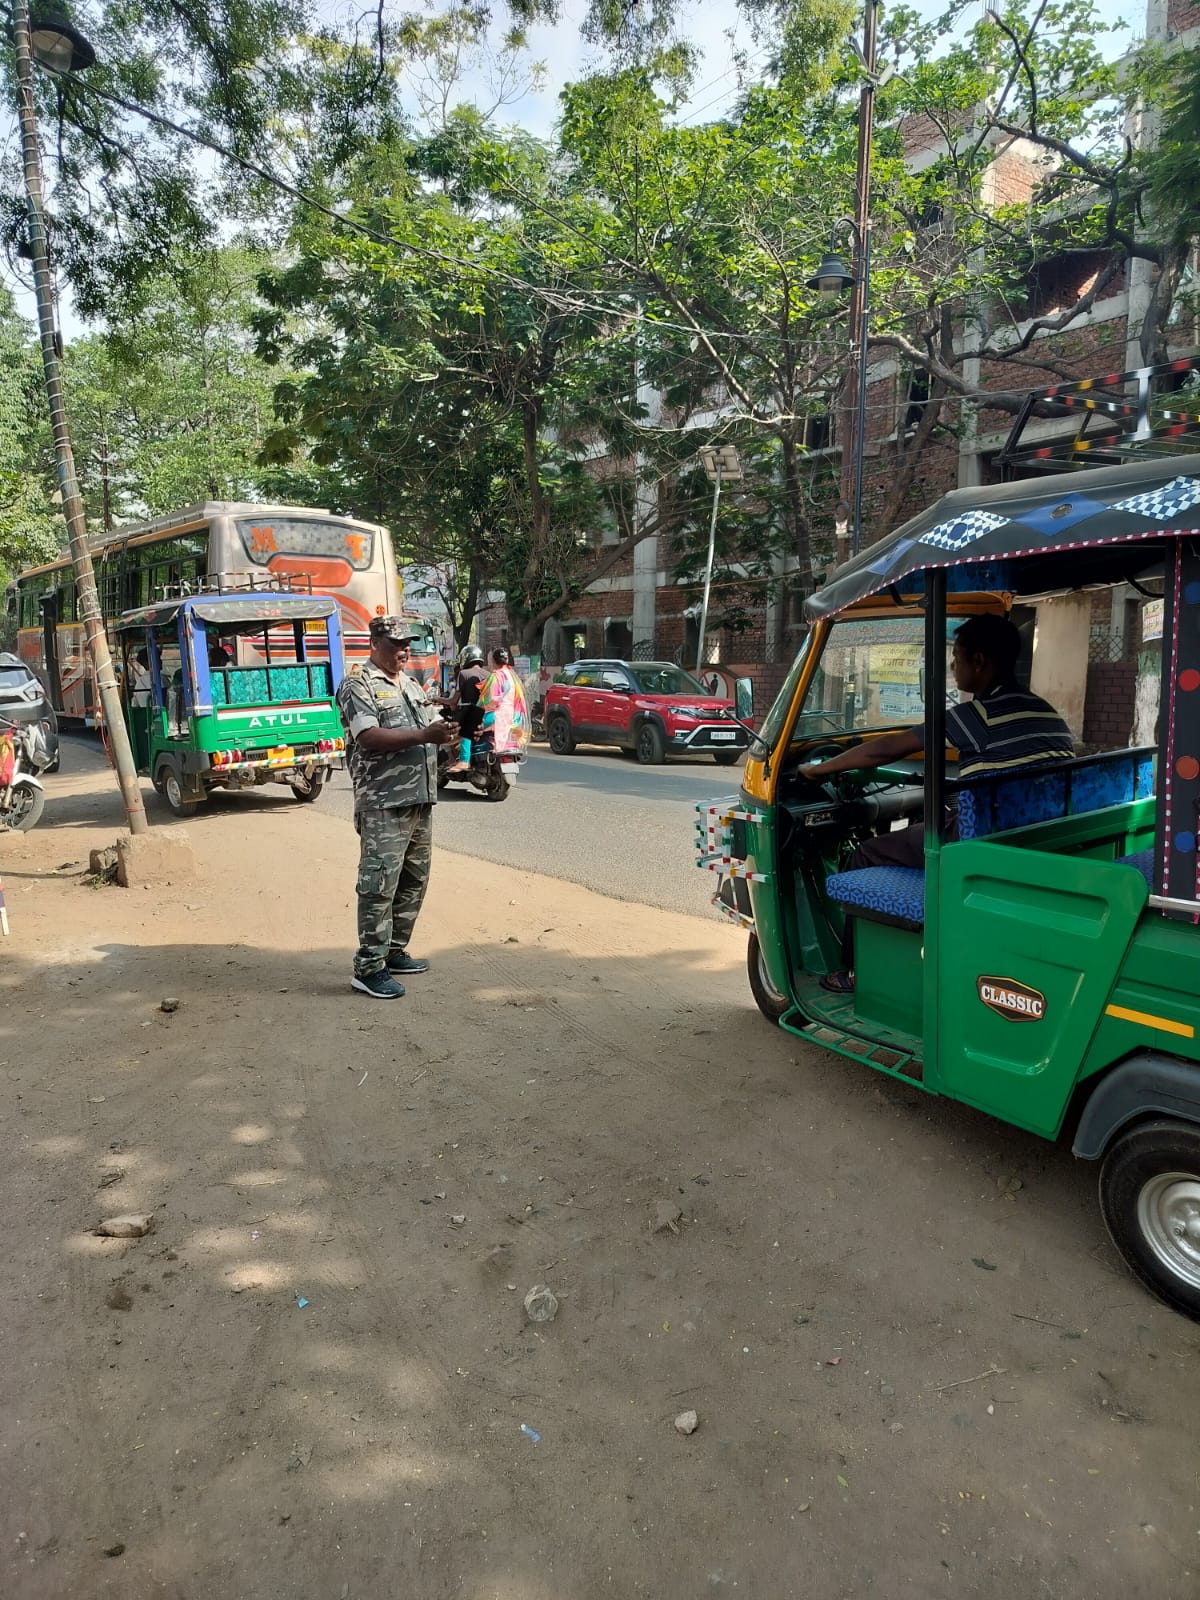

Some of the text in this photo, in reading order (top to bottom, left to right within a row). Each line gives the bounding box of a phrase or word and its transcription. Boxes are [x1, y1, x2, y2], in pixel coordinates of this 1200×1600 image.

[250, 527, 365, 559] M T
[249, 713, 308, 728] ATUL
[981, 985, 1042, 1016] CLASSIC
